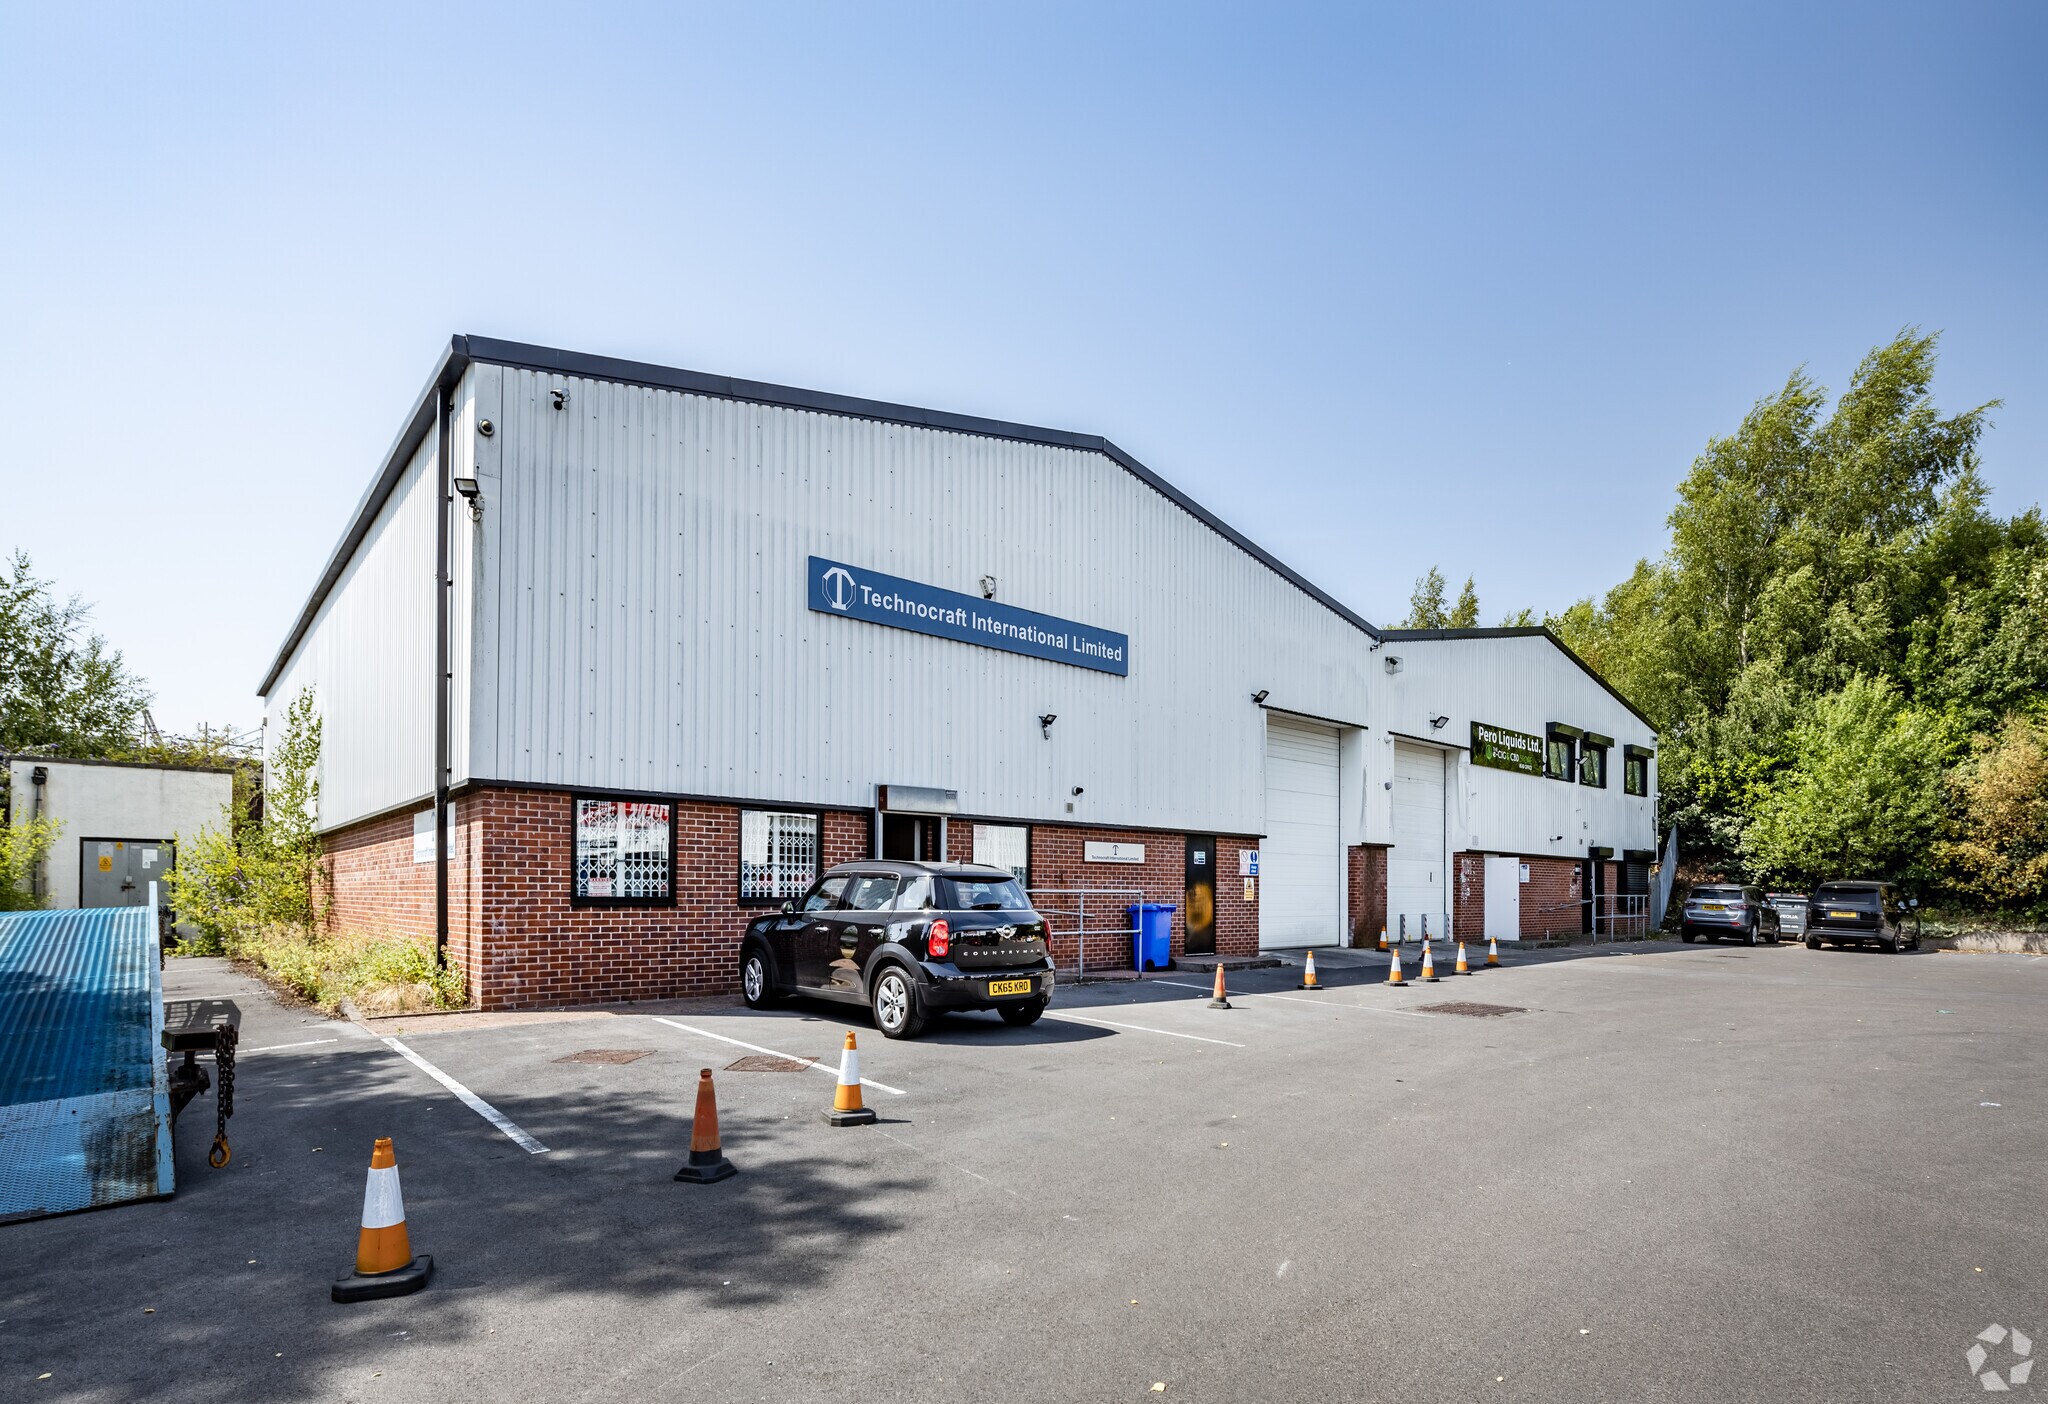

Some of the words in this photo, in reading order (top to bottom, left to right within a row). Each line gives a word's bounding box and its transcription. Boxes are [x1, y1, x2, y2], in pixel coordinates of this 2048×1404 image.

[860, 584, 967, 627] Technocraft
[972, 611, 1068, 650] International
[1073, 635, 1123, 662] Limited
[1478, 726, 1497, 743] Pero
[1498, 731, 1526, 750] Liquids
[1527, 738, 1541, 753] Ltd.
[992, 982, 1013, 994] CK65
